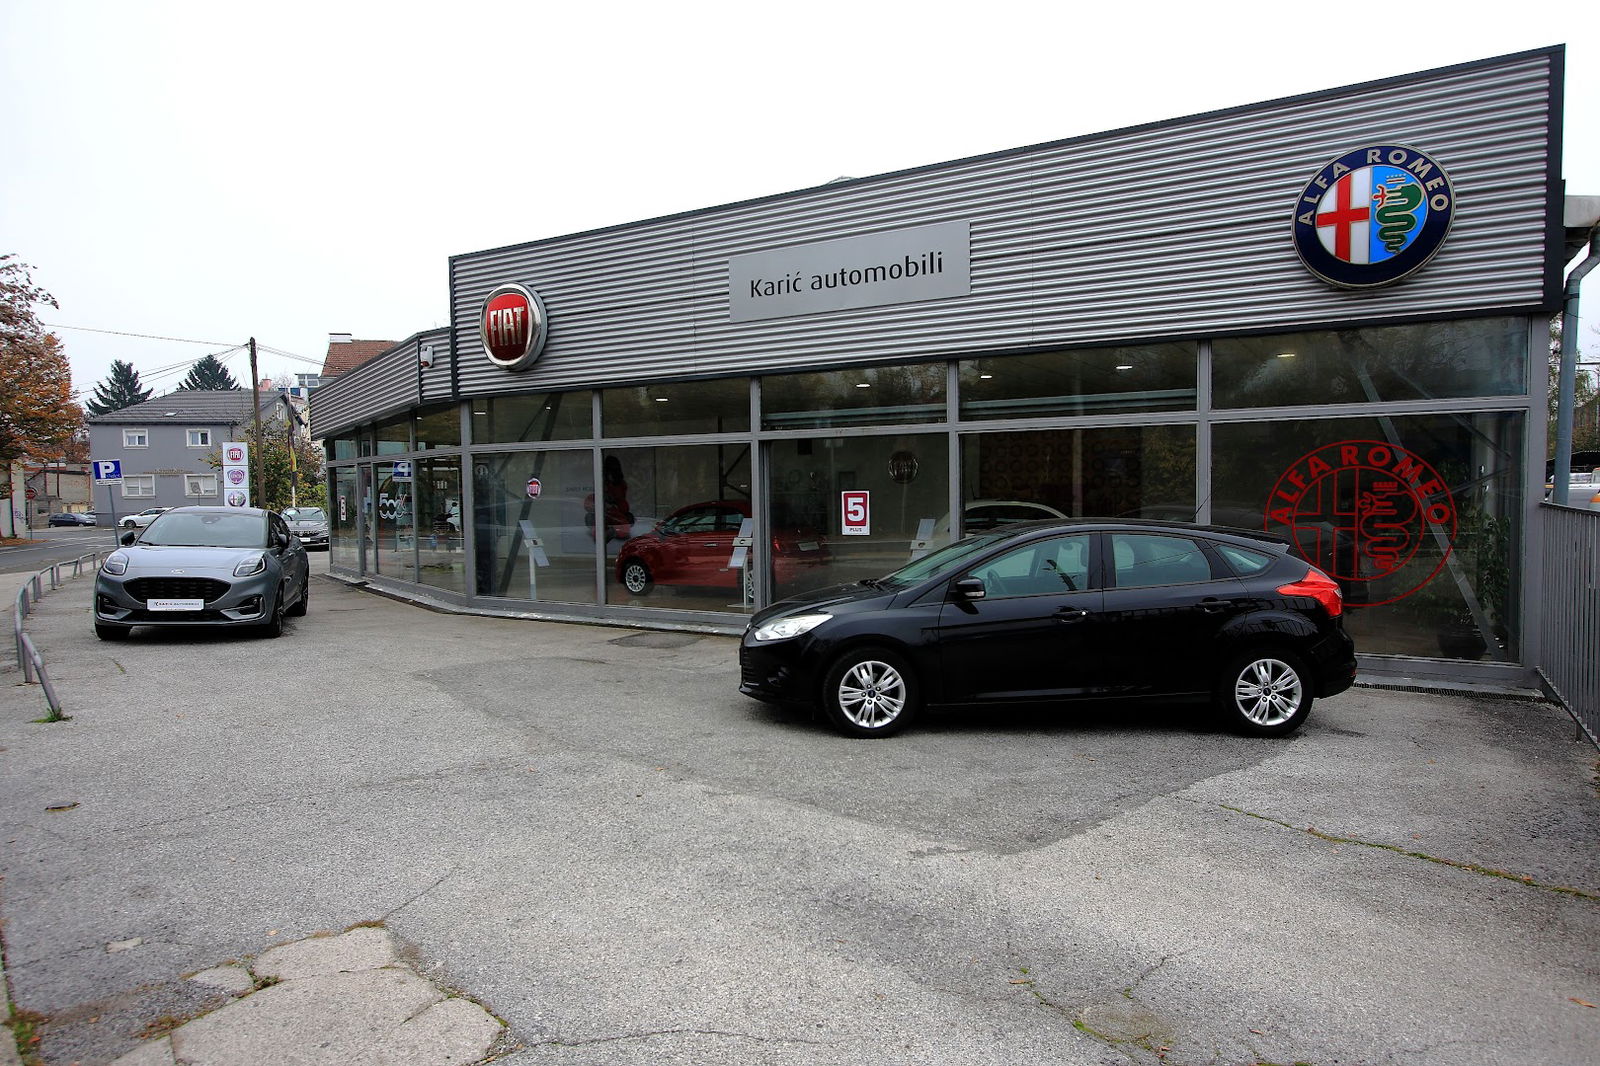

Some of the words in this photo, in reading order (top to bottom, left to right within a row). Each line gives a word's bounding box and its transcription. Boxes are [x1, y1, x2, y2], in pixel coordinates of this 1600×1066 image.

[1299, 162, 1351, 226] ALFA
[1366, 149, 1449, 212] ROMEO
[750, 271, 802, 298] Karić
[810, 251, 943, 291] automobili
[489, 306, 525, 347] FIAT
[98, 461, 116, 479] P
[1270, 455, 1332, 526] ALFA
[1340, 446, 1451, 525] ROMEO
[847, 497, 865, 522] 5
